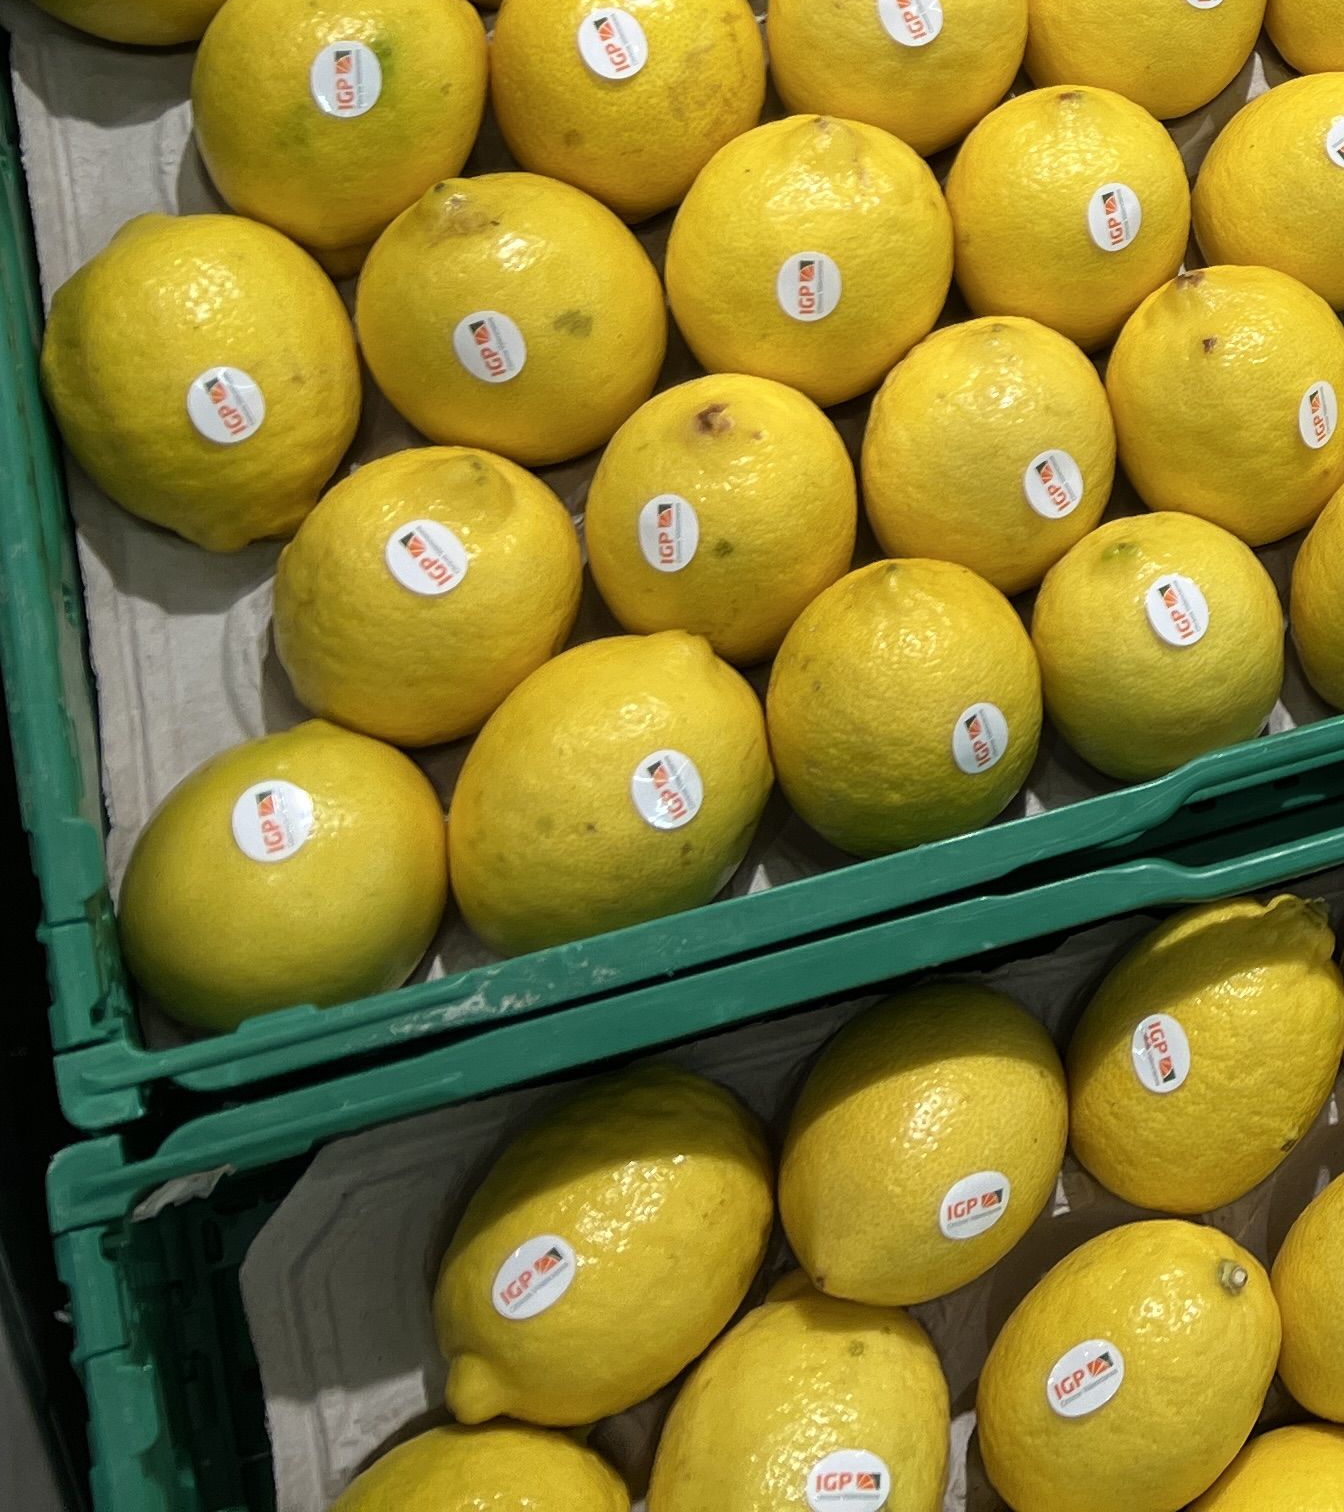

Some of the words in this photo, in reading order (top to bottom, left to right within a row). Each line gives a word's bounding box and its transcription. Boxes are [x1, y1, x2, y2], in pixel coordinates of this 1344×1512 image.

[605, 44, 631, 73] IGP
[336, 79, 355, 111] IGP
[798, 285, 817, 317] IGP
[659, 532, 675, 565] IGP
[420, 557, 453, 587] IGP
[947, 1197, 981, 1220] IGP
[500, 1270, 533, 1305] IGP
[1053, 1369, 1088, 1401] IGP
